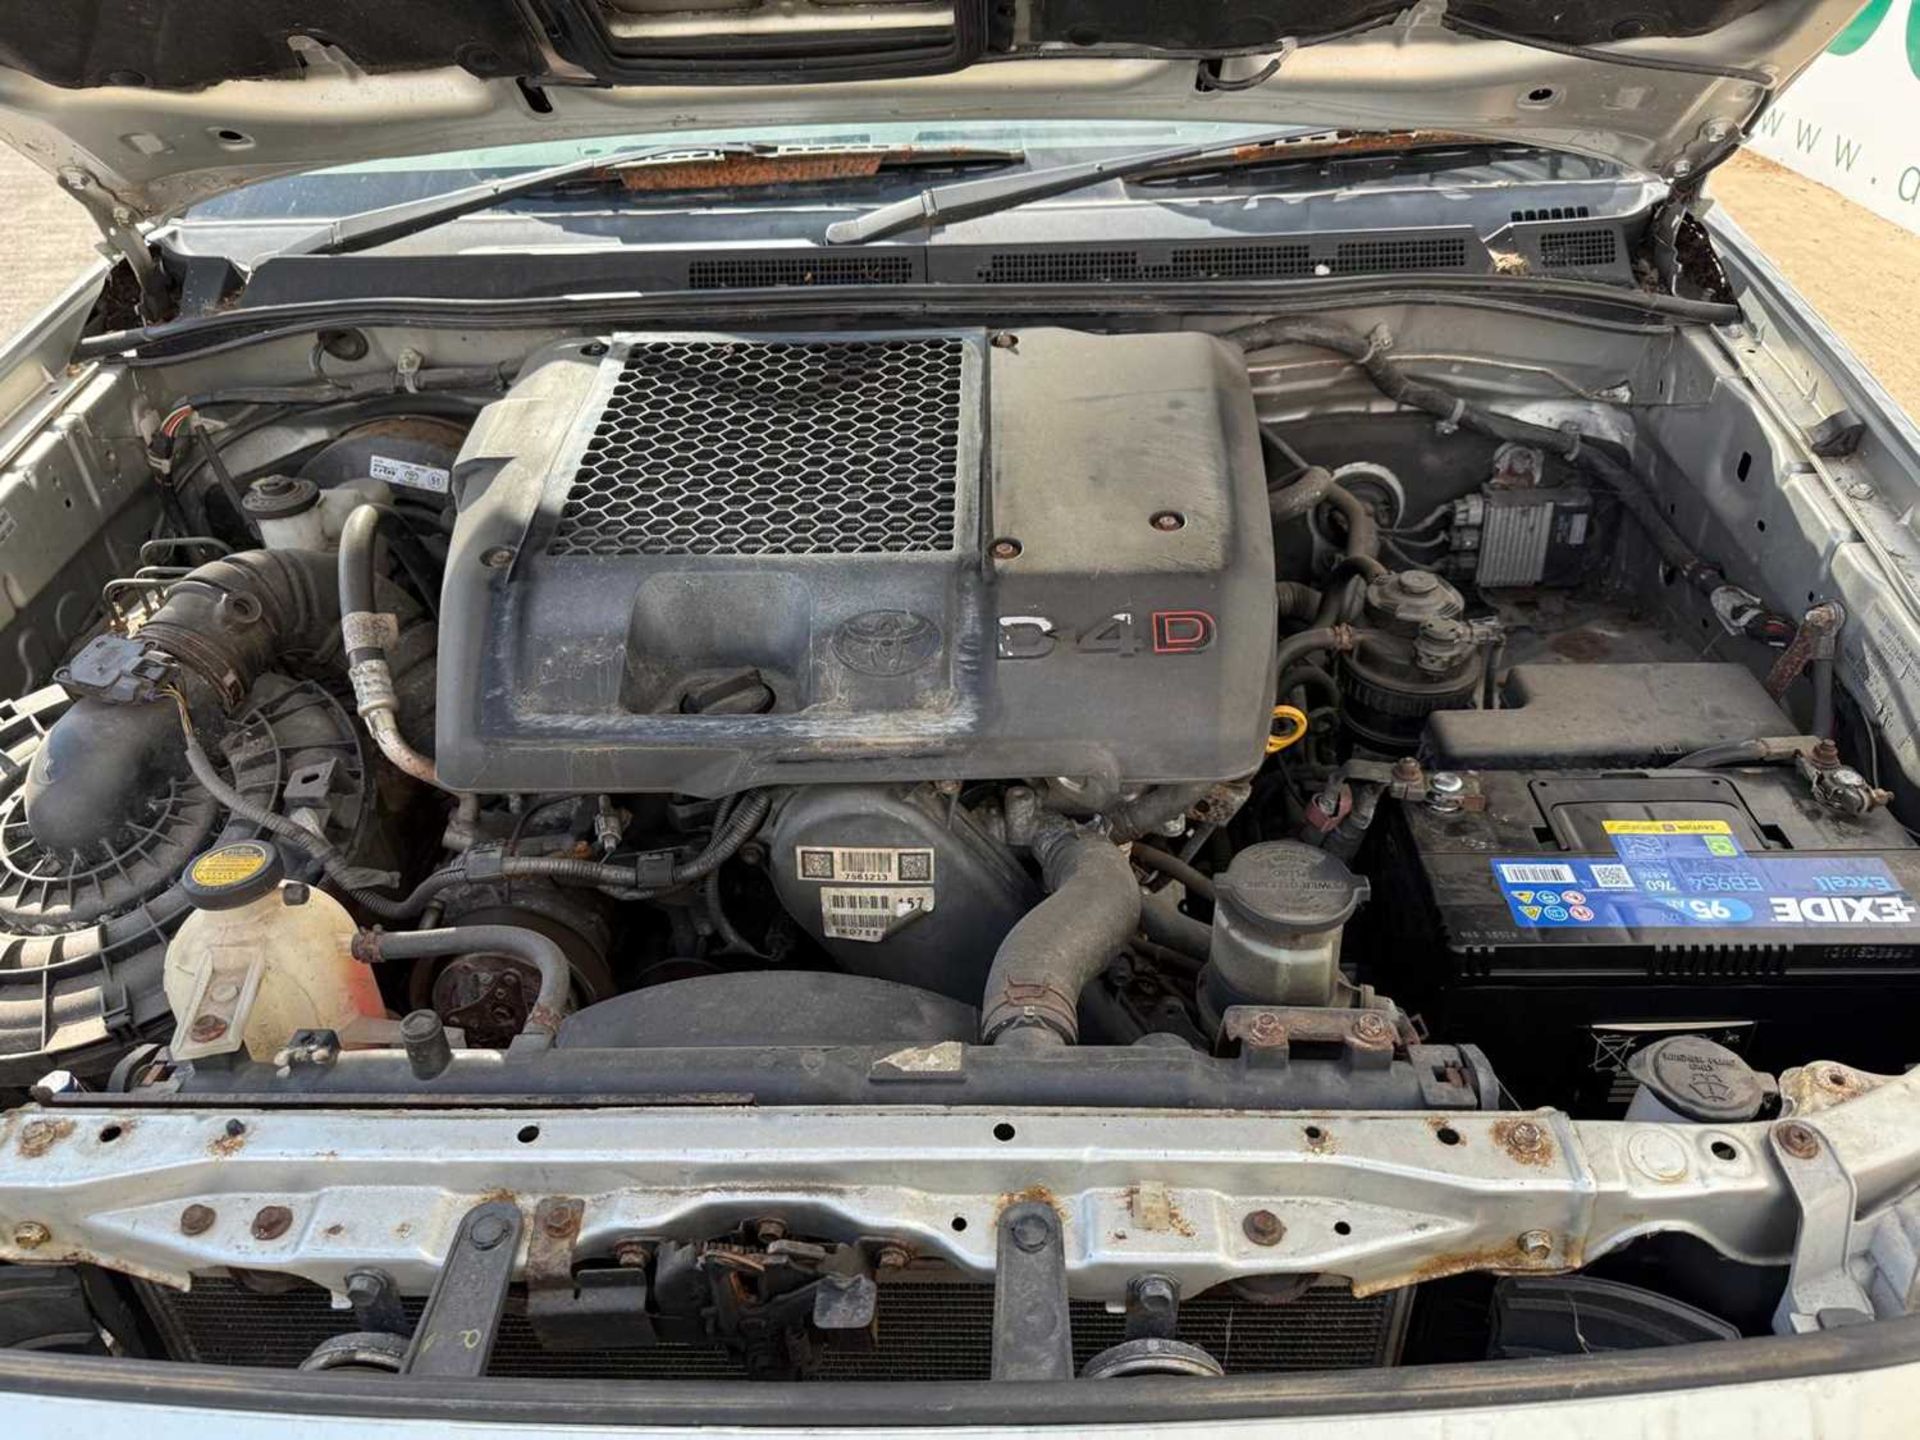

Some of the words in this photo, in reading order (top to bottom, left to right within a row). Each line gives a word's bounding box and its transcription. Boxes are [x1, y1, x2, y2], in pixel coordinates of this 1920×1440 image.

[1812, 876, 1893, 891] Excell
[1689, 900, 1731, 919] 95
[1769, 897, 1915, 922] EXIDE
